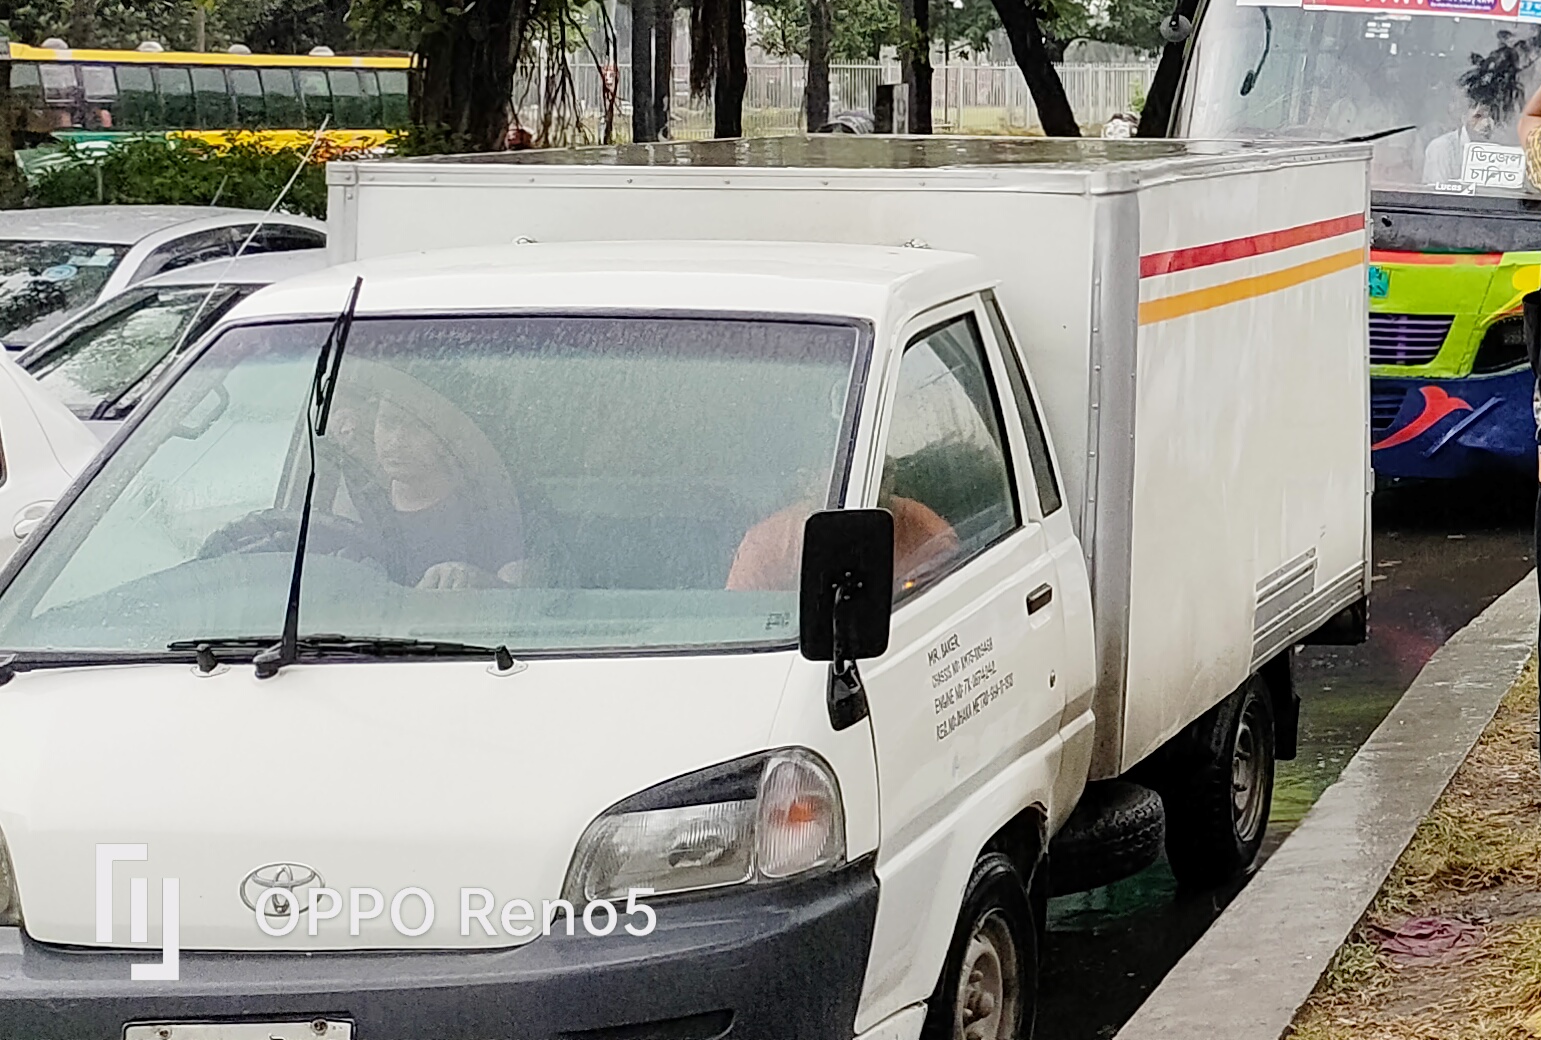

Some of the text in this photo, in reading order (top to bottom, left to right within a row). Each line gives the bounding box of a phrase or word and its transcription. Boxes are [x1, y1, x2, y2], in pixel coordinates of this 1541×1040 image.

[1471, 146, 1524, 165] ডিজেল
[1470, 166, 1519, 185] চালিত
[1434, 181, 1462, 192] Lucas
